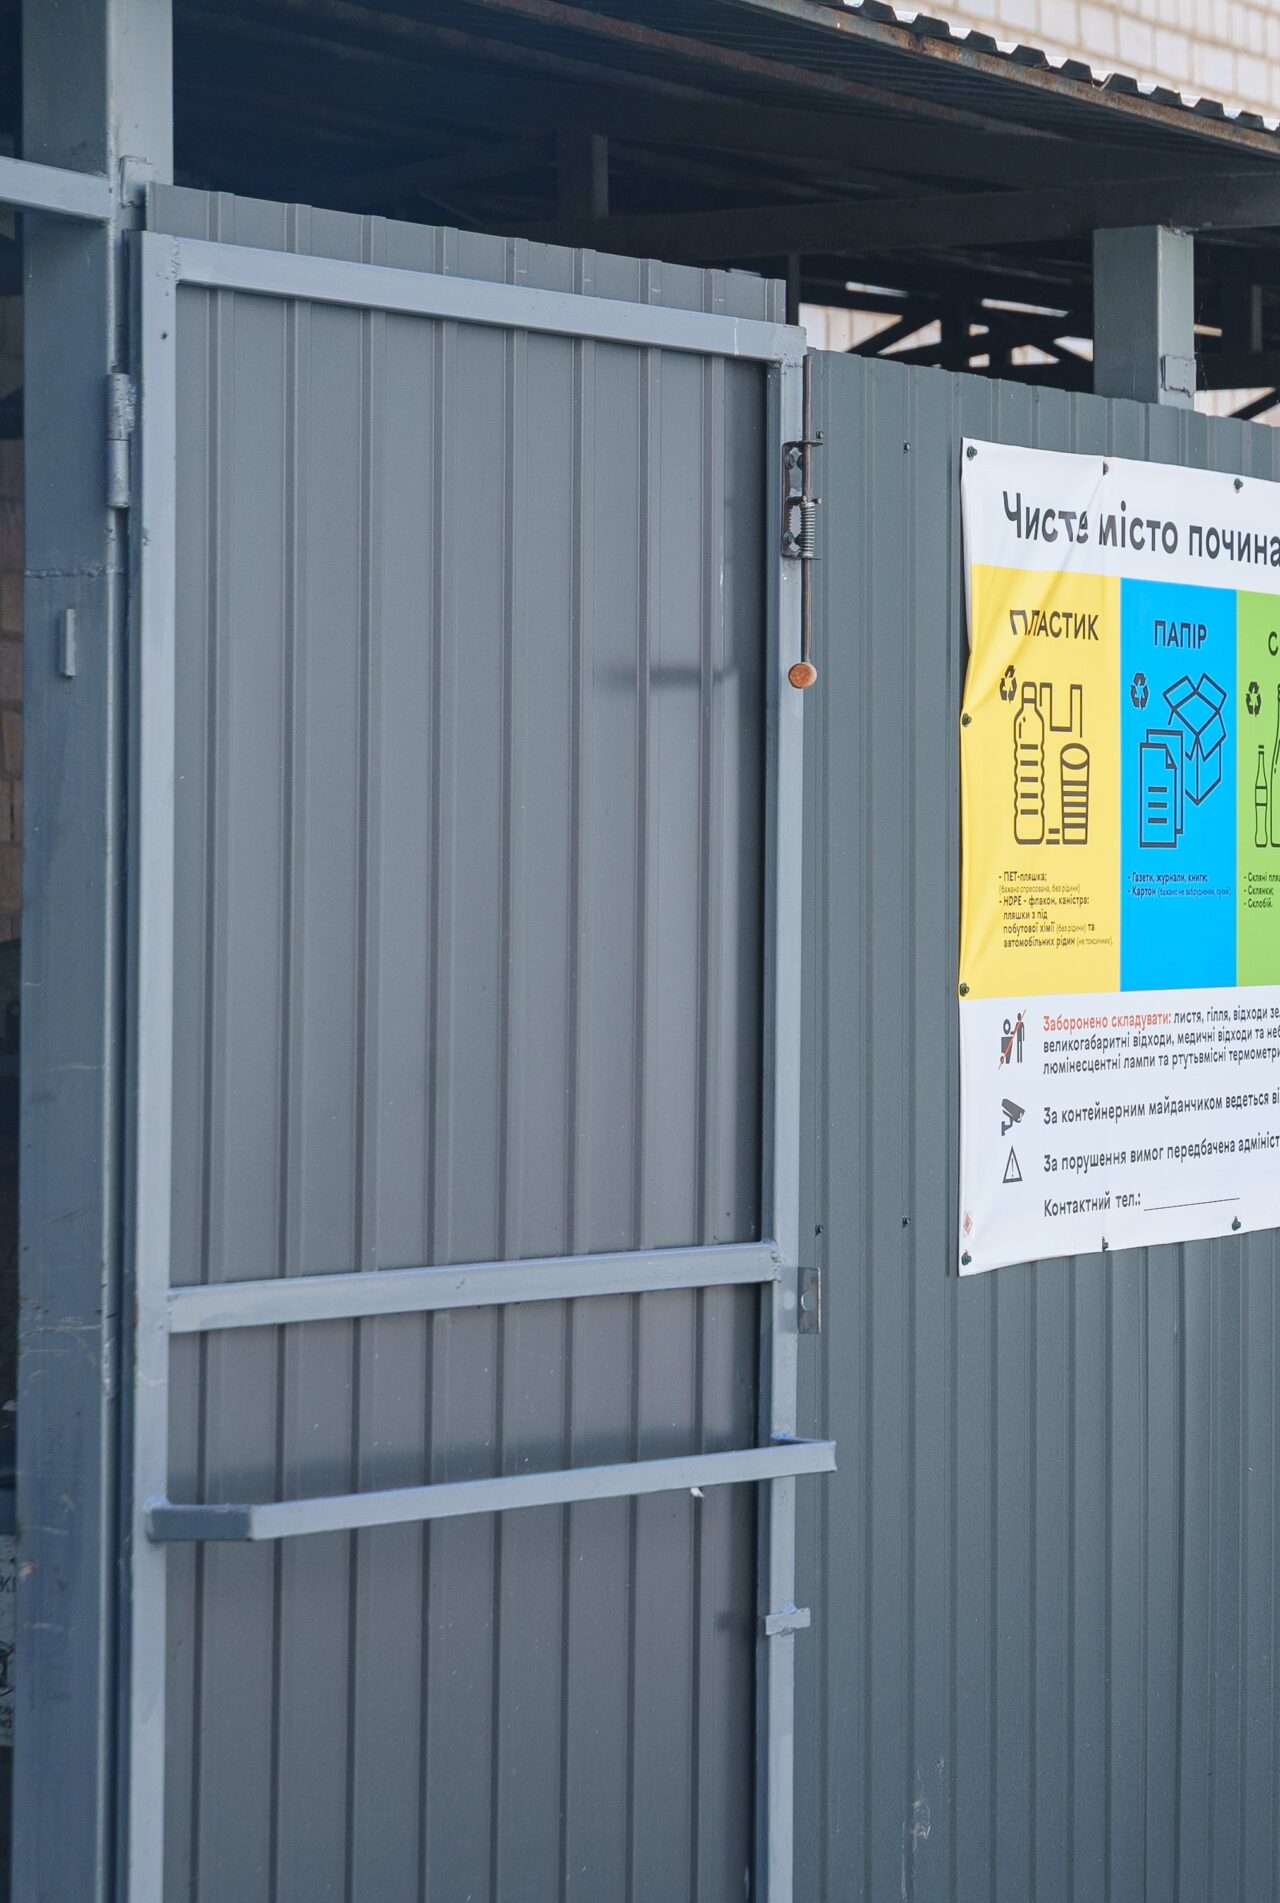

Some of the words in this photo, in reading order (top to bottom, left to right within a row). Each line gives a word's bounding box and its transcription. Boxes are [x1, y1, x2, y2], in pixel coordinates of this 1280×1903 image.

[1003, 491, 1088, 545] Чисте
[1099, 501, 1178, 554] місто
[1010, 610, 1099, 641] ПЛАСТИК
[1154, 620, 1207, 648] ПАПІР
[1003, 871, 1047, 882] ПЕТ-пляшка;
[1132, 872, 1155, 883] Газети,
[1247, 872, 1268, 882] Скляні
[1132, 886, 1156, 898] Картон
[1247, 885, 1274, 896] Склянки;
[1003, 895, 1022, 906] HDPE
[1028, 895, 1057, 908] флакон,
[1247, 897, 1273, 908] Склобій.
[1003, 911, 1031, 920] пляшки
[1031, 911, 1036, 920] з
[1037, 909, 1048, 920] під
[1003, 922, 1038, 937] побутової
[1039, 921, 1056, 933] хімії
[1087, 923, 1095, 932] та
[1003, 936, 1055, 948] автомобільних
[1056, 935, 1076, 949] рідин
[1043, 1015, 1108, 1033] Заборонено
[1111, 1012, 1172, 1032] складувати:
[1173, 1008, 1204, 1025] листя,
[1206, 1006, 1231, 1023] гілля,
[1233, 1004, 1268, 1022] відходи
[1043, 1032, 1131, 1054] великогабаритні
[1133, 1031, 1175, 1050] відходи,
[1177, 1026, 1216, 1045] медичні
[1217, 1024, 1253, 1043] відходи
[1255, 1026, 1265, 1039] та
[1043, 1055, 1121, 1075] люмінесцентні
[1123, 1051, 1156, 1069] лампи
[1158, 1052, 1169, 1066] та
[1172, 1047, 1227, 1070] ртутьвмісні
[1043, 1106, 1058, 1126] За
[1061, 1101, 1146, 1129] контейнерним
[1148, 1094, 1223, 1118] майданчиком
[1225, 1091, 1269, 1114] ведеться
[1043, 1153, 1058, 1174] За
[1061, 1145, 1127, 1174] порушення
[1130, 1145, 1164, 1164] вимог
[1166, 1137, 1235, 1165] передбачена
[1043, 1190, 1111, 1217] Контактний
[1114, 1188, 1142, 1209] тел.:
